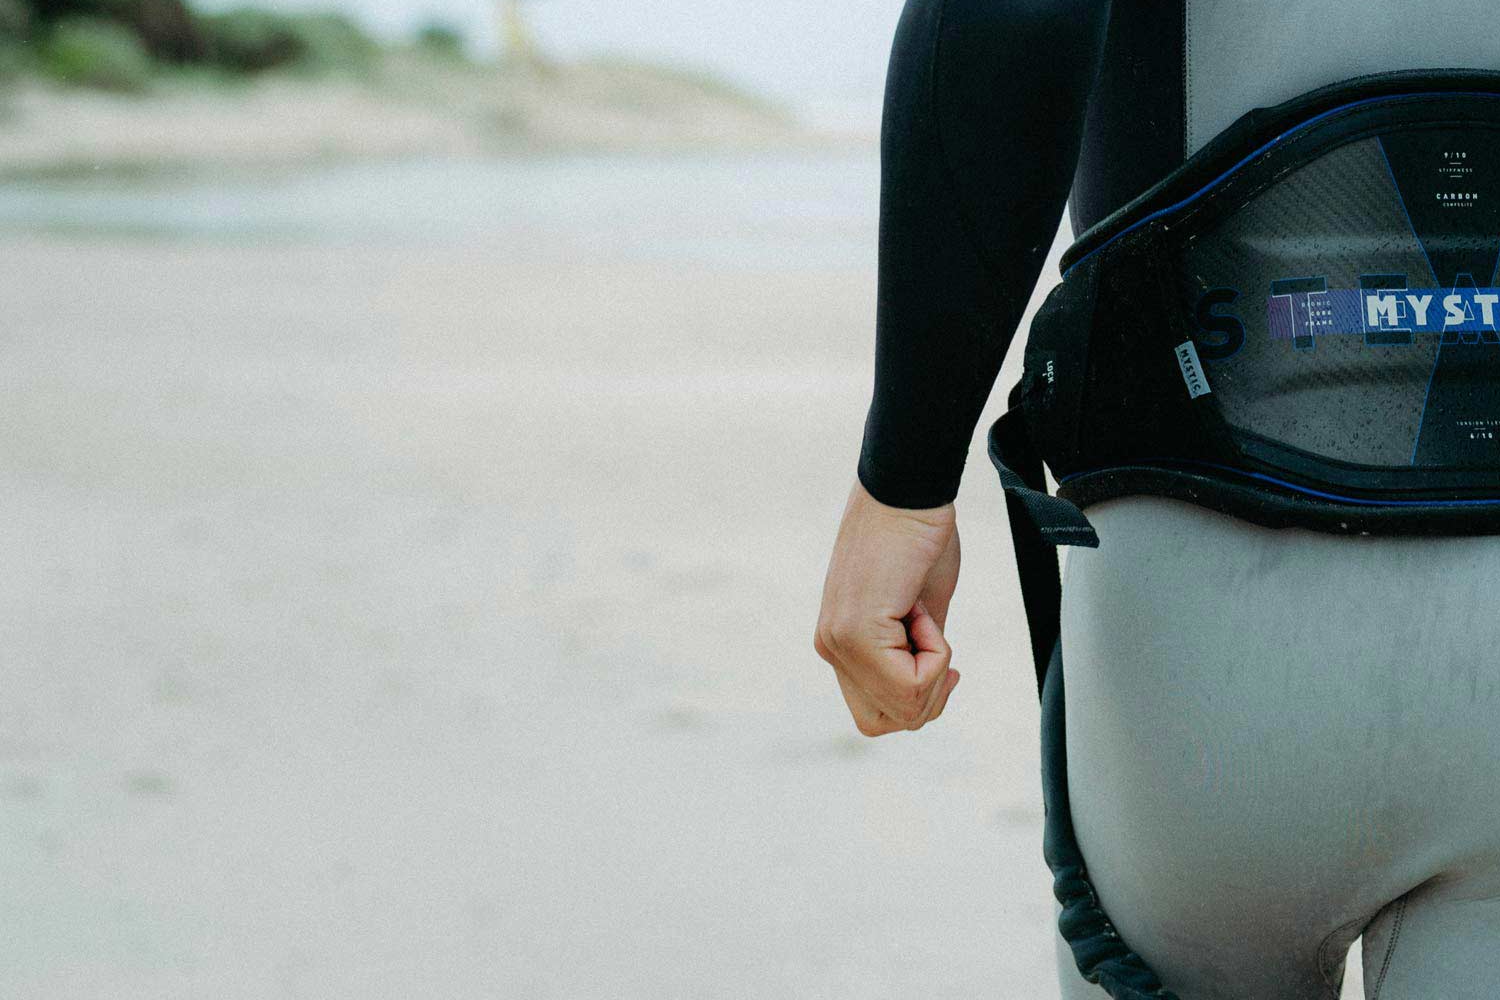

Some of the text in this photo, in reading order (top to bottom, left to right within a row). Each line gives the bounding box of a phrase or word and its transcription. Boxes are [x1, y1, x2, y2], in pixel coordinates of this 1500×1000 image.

[1436, 192, 1478, 200] CARBON
[1046, 360, 1054, 384] LOCK
[1180, 349, 1201, 391] MYSTIC
